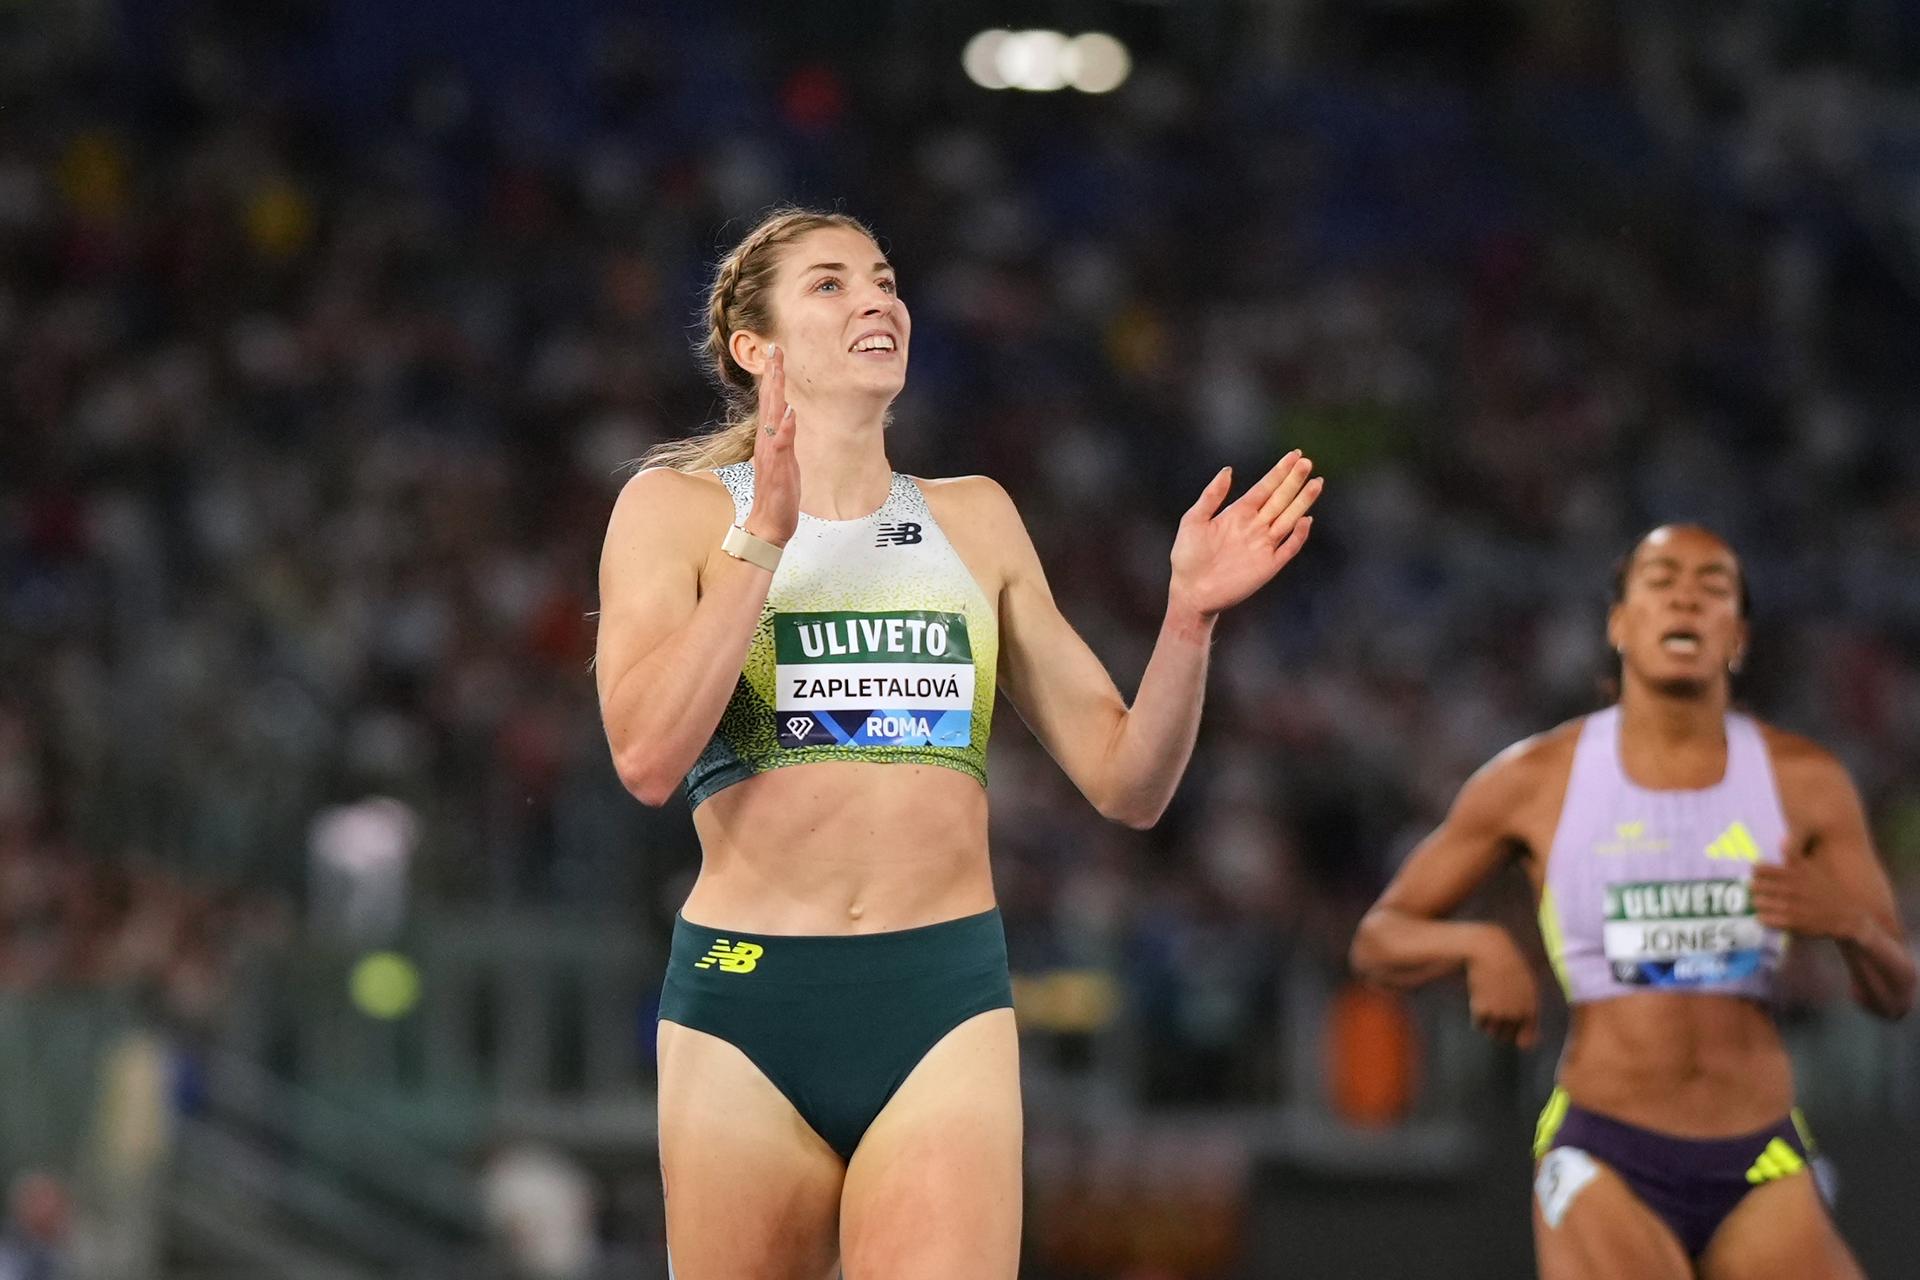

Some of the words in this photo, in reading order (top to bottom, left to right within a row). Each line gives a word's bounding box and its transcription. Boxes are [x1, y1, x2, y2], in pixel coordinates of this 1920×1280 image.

[798, 618, 947, 658] ULIVETO
[793, 674, 960, 698] ZAPLETALOVÁ
[866, 716, 931, 737] ROMA
[1622, 884, 1745, 918] ULIVETO
